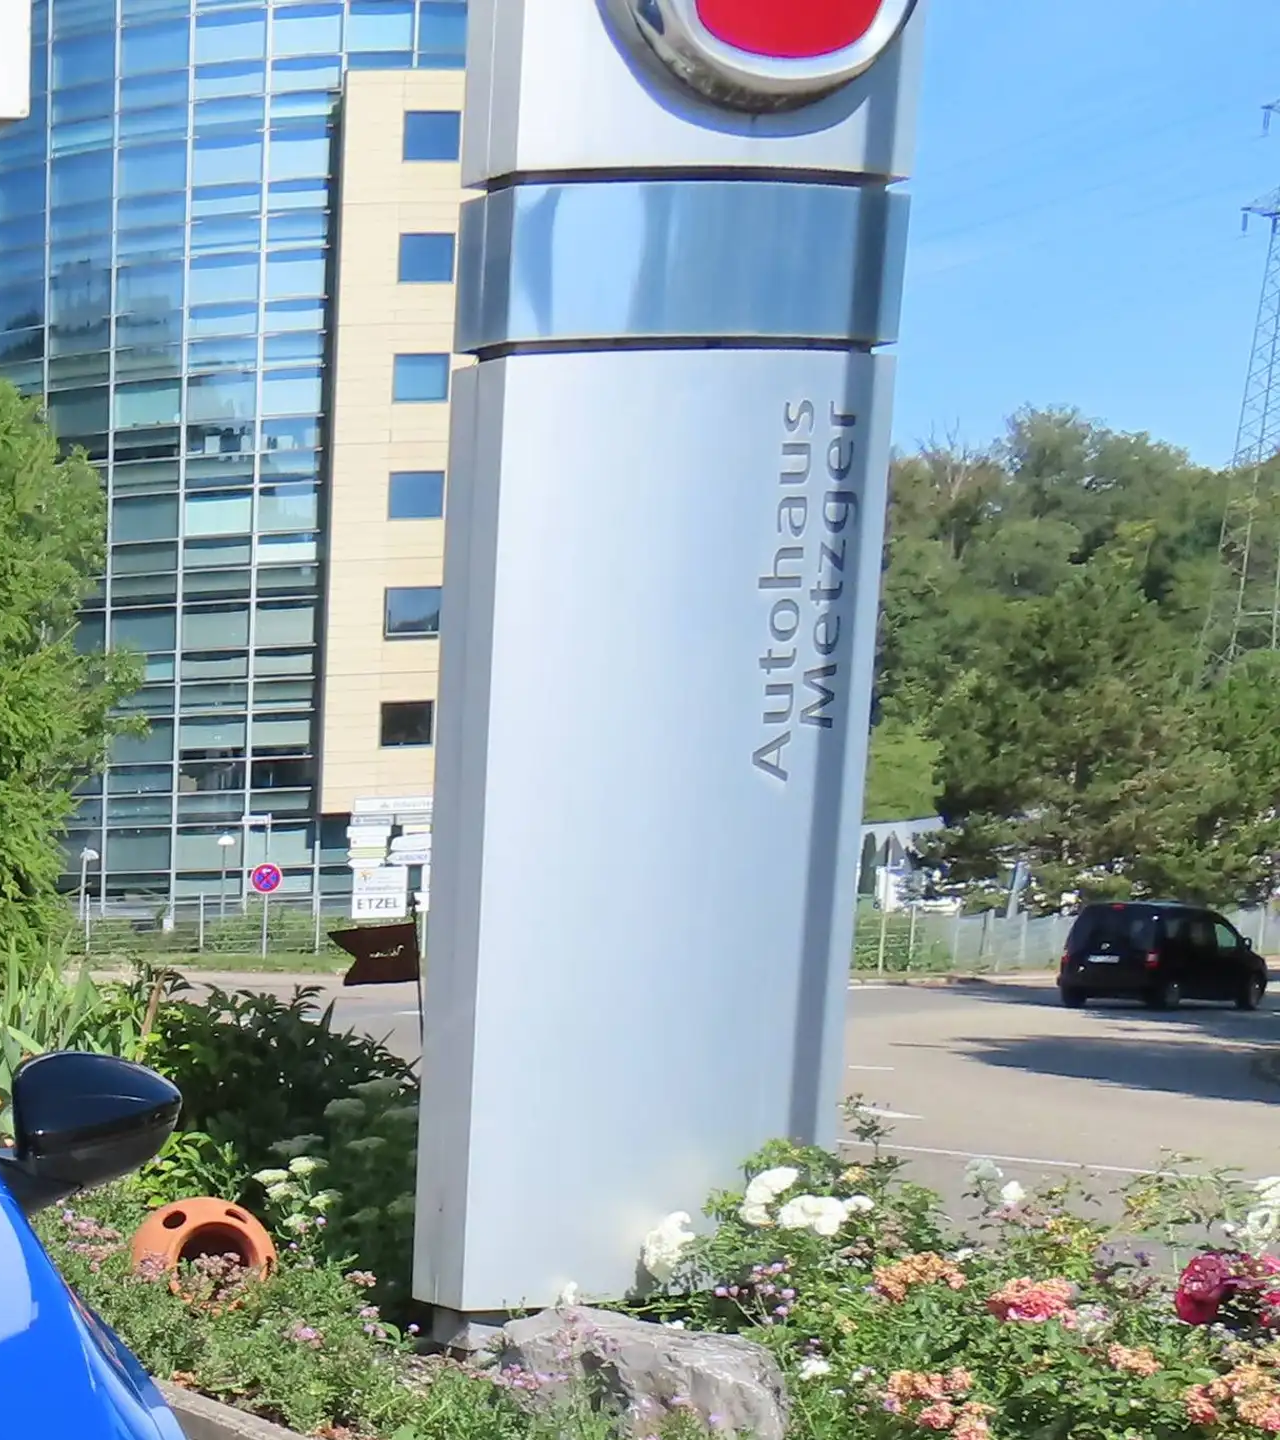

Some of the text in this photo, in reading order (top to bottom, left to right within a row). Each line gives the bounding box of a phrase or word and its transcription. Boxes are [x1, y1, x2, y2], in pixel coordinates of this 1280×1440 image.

[751, 396, 817, 783] Autohaus
[799, 400, 861, 730] Metzger
[356, 897, 401, 911] ETZEL
